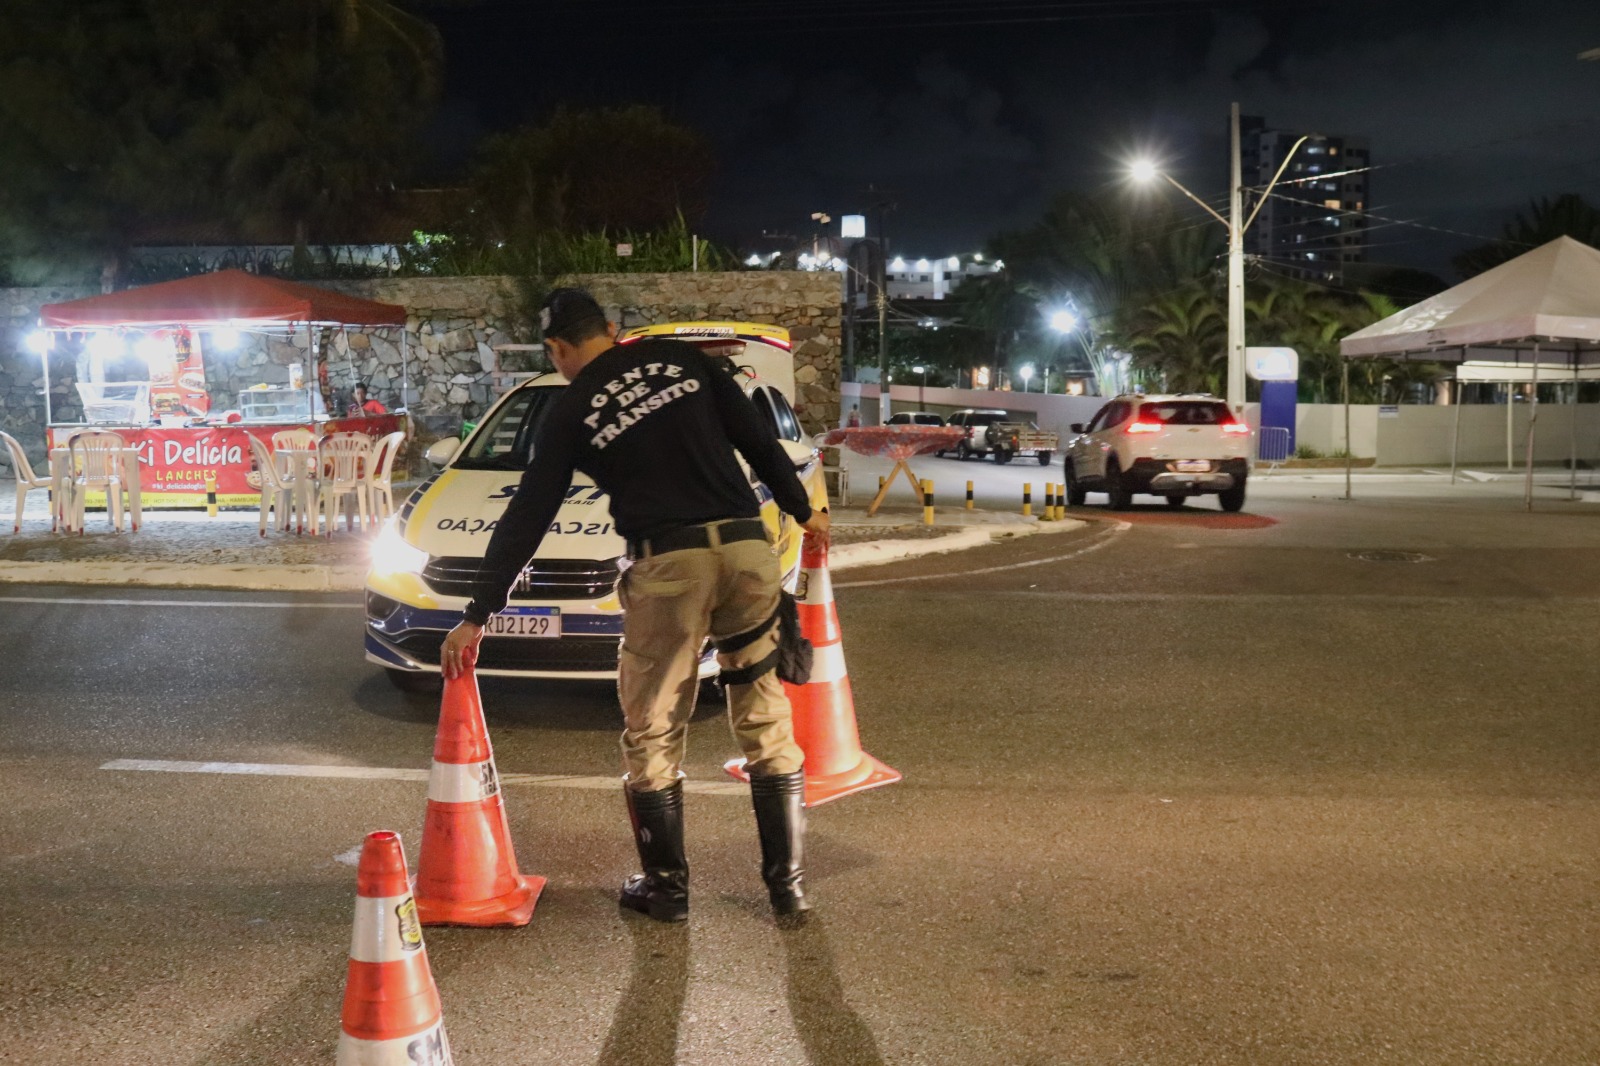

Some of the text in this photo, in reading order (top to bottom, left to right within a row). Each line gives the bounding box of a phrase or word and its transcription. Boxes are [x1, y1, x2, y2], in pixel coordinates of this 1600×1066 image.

[583, 362, 683, 430] AGENTE
[615, 381, 651, 407] DE
[590, 378, 700, 450] TRÂNSITO
[130, 437, 242, 466] Ki Delícia
[156, 469, 217, 481] LANCHES
